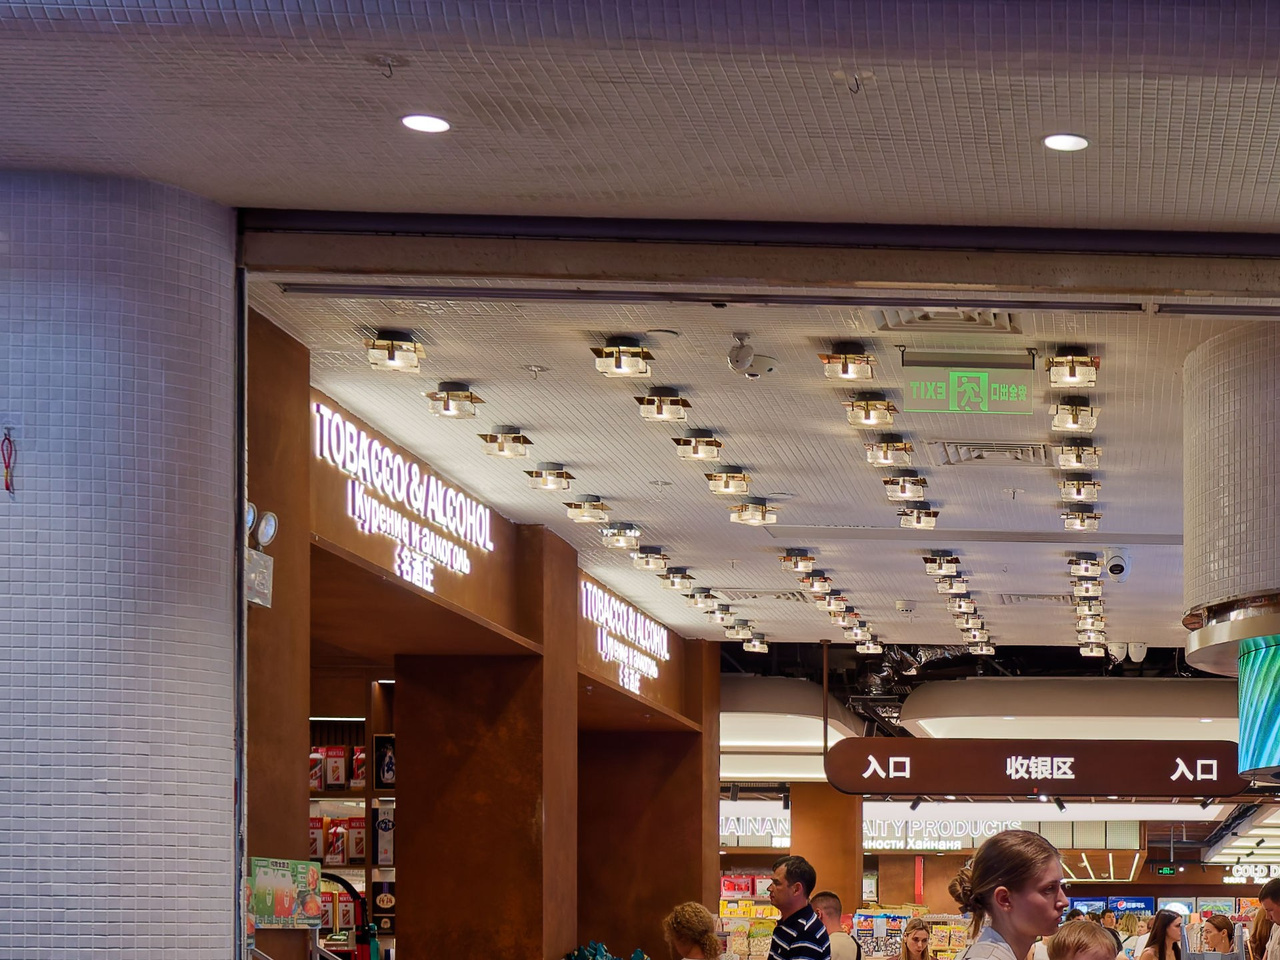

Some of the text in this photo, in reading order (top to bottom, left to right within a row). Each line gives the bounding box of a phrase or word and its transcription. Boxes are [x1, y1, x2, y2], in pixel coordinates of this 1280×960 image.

[313, 402, 494, 551] TOBACCO & ALCOHOL
[347, 479, 410, 547] Курение
[421, 527, 471, 575] алкоголь
[394, 546, 435, 593] 名酒庄
[581, 580, 627, 641] TOBACCO
[635, 611, 670, 661] ALCOHOL
[862, 755, 911, 779] 入口
[1005, 756, 1075, 780] 收银区
[1170, 758, 1218, 781] 入口
[906, 837, 962, 850] Хайнаня
[1231, 864, 1268, 878] COLD
